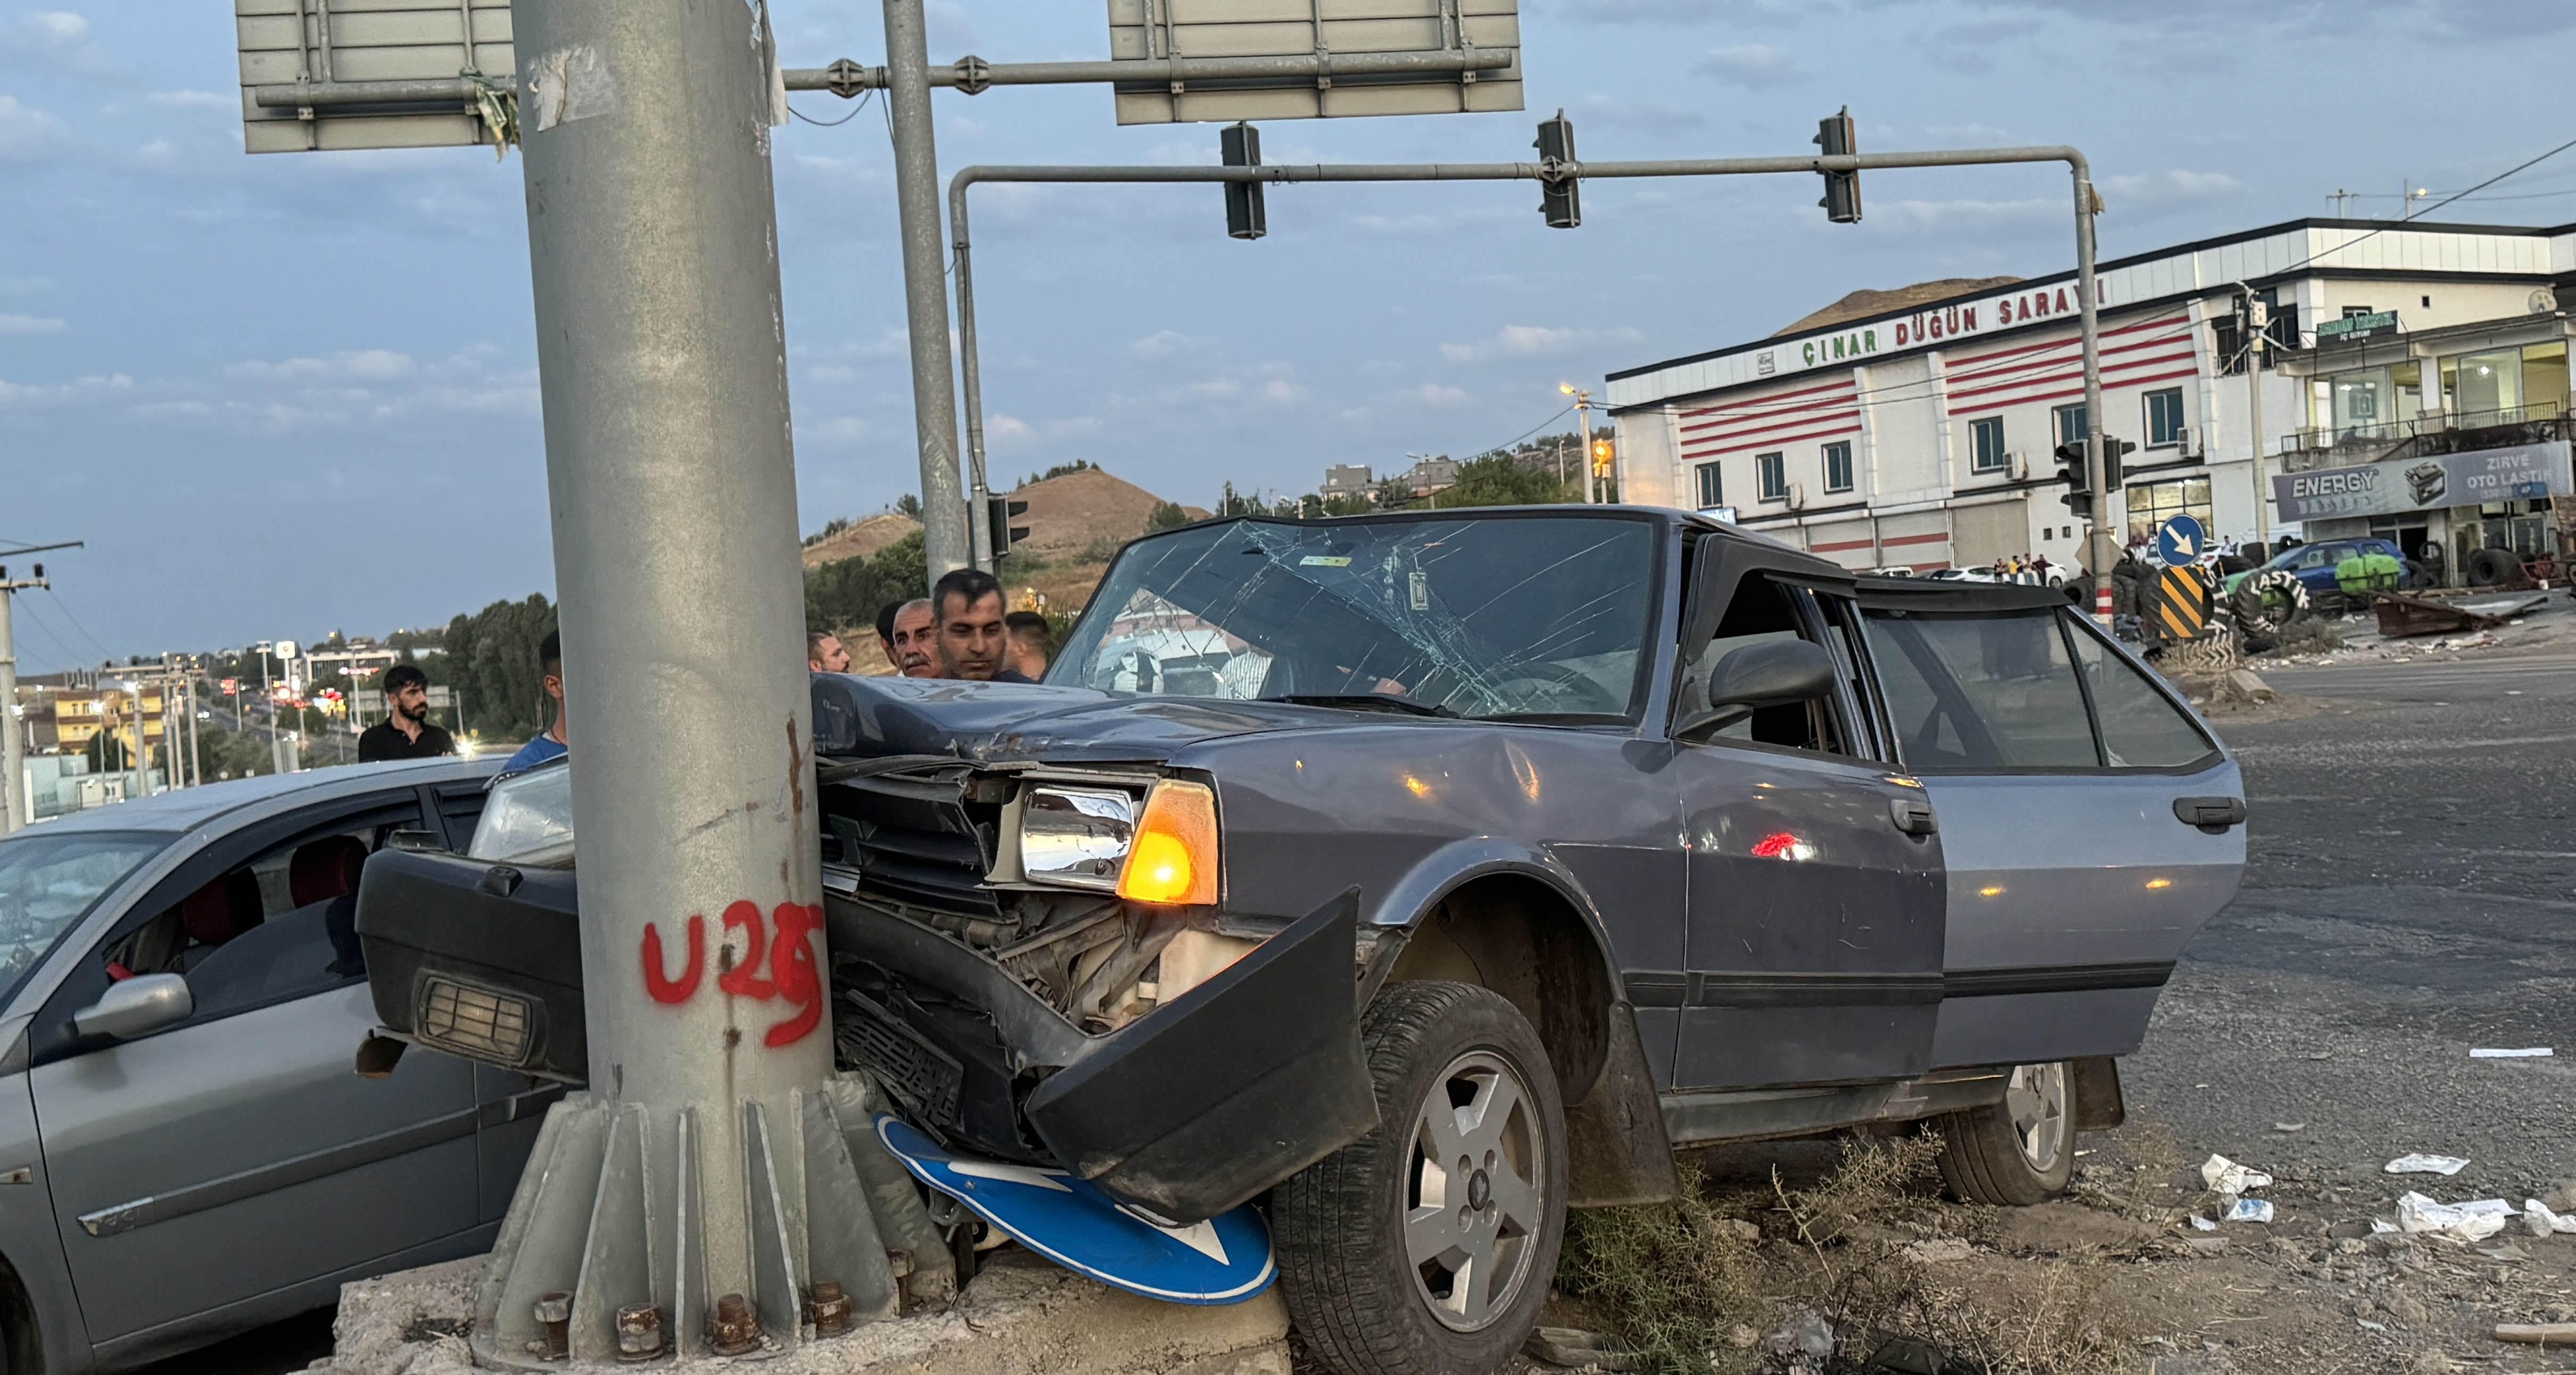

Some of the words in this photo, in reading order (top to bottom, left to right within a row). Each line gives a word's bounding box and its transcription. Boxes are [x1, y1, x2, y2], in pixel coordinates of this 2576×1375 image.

[1803, 330, 1877, 366] ÇINAR
[1896, 306, 1978, 346] DÜĞÜN
[2292, 471, 2374, 498] ENERGY
[2467, 475, 2496, 489] OTO
